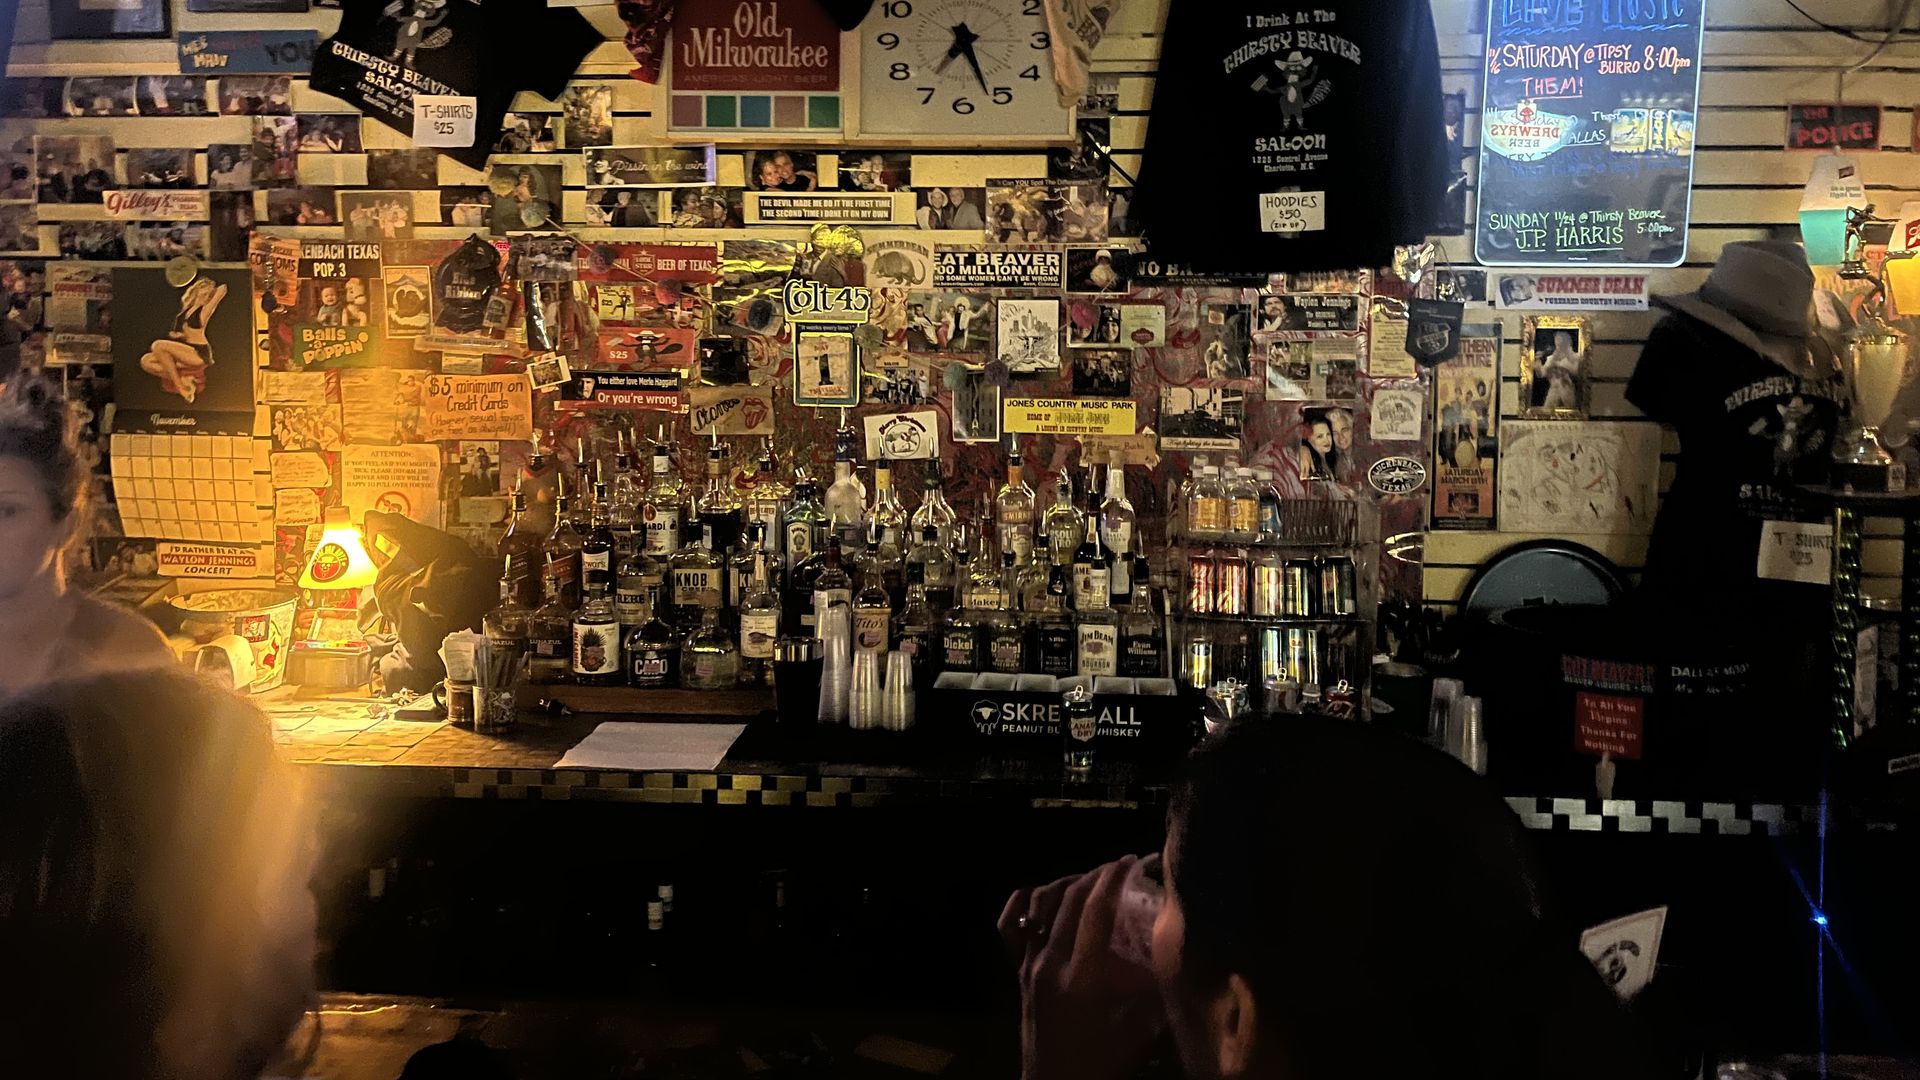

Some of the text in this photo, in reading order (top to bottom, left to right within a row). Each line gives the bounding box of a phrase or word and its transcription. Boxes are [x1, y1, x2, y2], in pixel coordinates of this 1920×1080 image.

[881, 1, 912, 18] 10
[1022, 0, 1041, 16] 2
[733, 2, 784, 38] Old
[1246, 10, 1336, 28] I Drink At The
[683, 27, 829, 67] Milwaukee
[877, 33, 900, 50] 9
[1030, 32, 1051, 49] 3
[332, 41, 399, 78] THIRSTY
[1223, 30, 1361, 74] THIRSTY BEAVER
[1503, 44, 1584, 70] SATURDAY
[1584, 49, 1595, 63] @
[1594, 44, 1632, 61] TIPSY
[889, 63, 910, 80] 8
[1019, 65, 1040, 81] 4
[1598, 61, 1641, 74] BURRO
[1522, 76, 1583, 96] THEM!
[917, 88, 935, 104] 7
[992, 88, 1013, 104] 5
[421, 104, 473, 119] T-SHIRTS
[952, 98, 975, 114] 6
[434, 122, 454, 134] $25
[1797, 121, 1873, 146] POLICE
[1255, 134, 1326, 152] SALOON
[107, 191, 174, 214] Gilley's
[760, 199, 891, 208] THE DEVIL MADE ME DO IT THE FIRST TIME
[1266, 196, 1317, 208] HOODIES
[762, 209, 774, 217] THE
[776, 209, 802, 217] SECOND
[803, 209, 819, 217] TIME
[843, 209, 849, 217] IT
[850, 209, 859, 217] ON
[861, 209, 871, 217] MY
[872, 209, 888, 217] OWN
[1279, 209, 1301, 219] $50
[1489, 212, 1549, 230] SUNDAY
[1554, 211, 1576, 226] 11/24
[1589, 210, 1624, 228] Thirsty
[1555, 226, 1624, 246] HARRIS
[347, 244, 379, 259] TEXAS
[976, 254, 1060, 265] BEAVER
[251, 252, 296, 271] COOMS
[313, 262, 347, 277] POP. 3
[657, 259, 712, 271] BEER OF TEXAS
[960, 265, 1021, 275] MILLION
[1027, 266, 1060, 275] MEN
[783, 279, 871, 316] Colt 45
[302, 328, 346, 342] Balls
[609, 351, 628, 359] $25
[429, 376, 523, 397] $5 minimum on
[598, 376, 678, 387] You either love Merle Haggard
[447, 393, 509, 412] Credit Cards
[598, 393, 678, 407] Or you're wrong
[1007, 400, 1133, 410] JONES COUNTRY MUSIC PARK
[150, 413, 197, 426] November
[1372, 459, 1424, 475] LUCKENBAC
[182, 546, 214, 554] RATHER
[162, 555, 255, 566] WAYLON JENNINGS
[184, 566, 232, 575] CONCERT
[675, 573, 708, 586] KNOB
[856, 618, 885, 629] Tito's
[944, 637, 973, 650] Dickel
[1081, 630, 1114, 645] JIM BEAM
[1002, 724, 1043, 734] PEANUT
[1580, 725, 1637, 741] Thanks For
